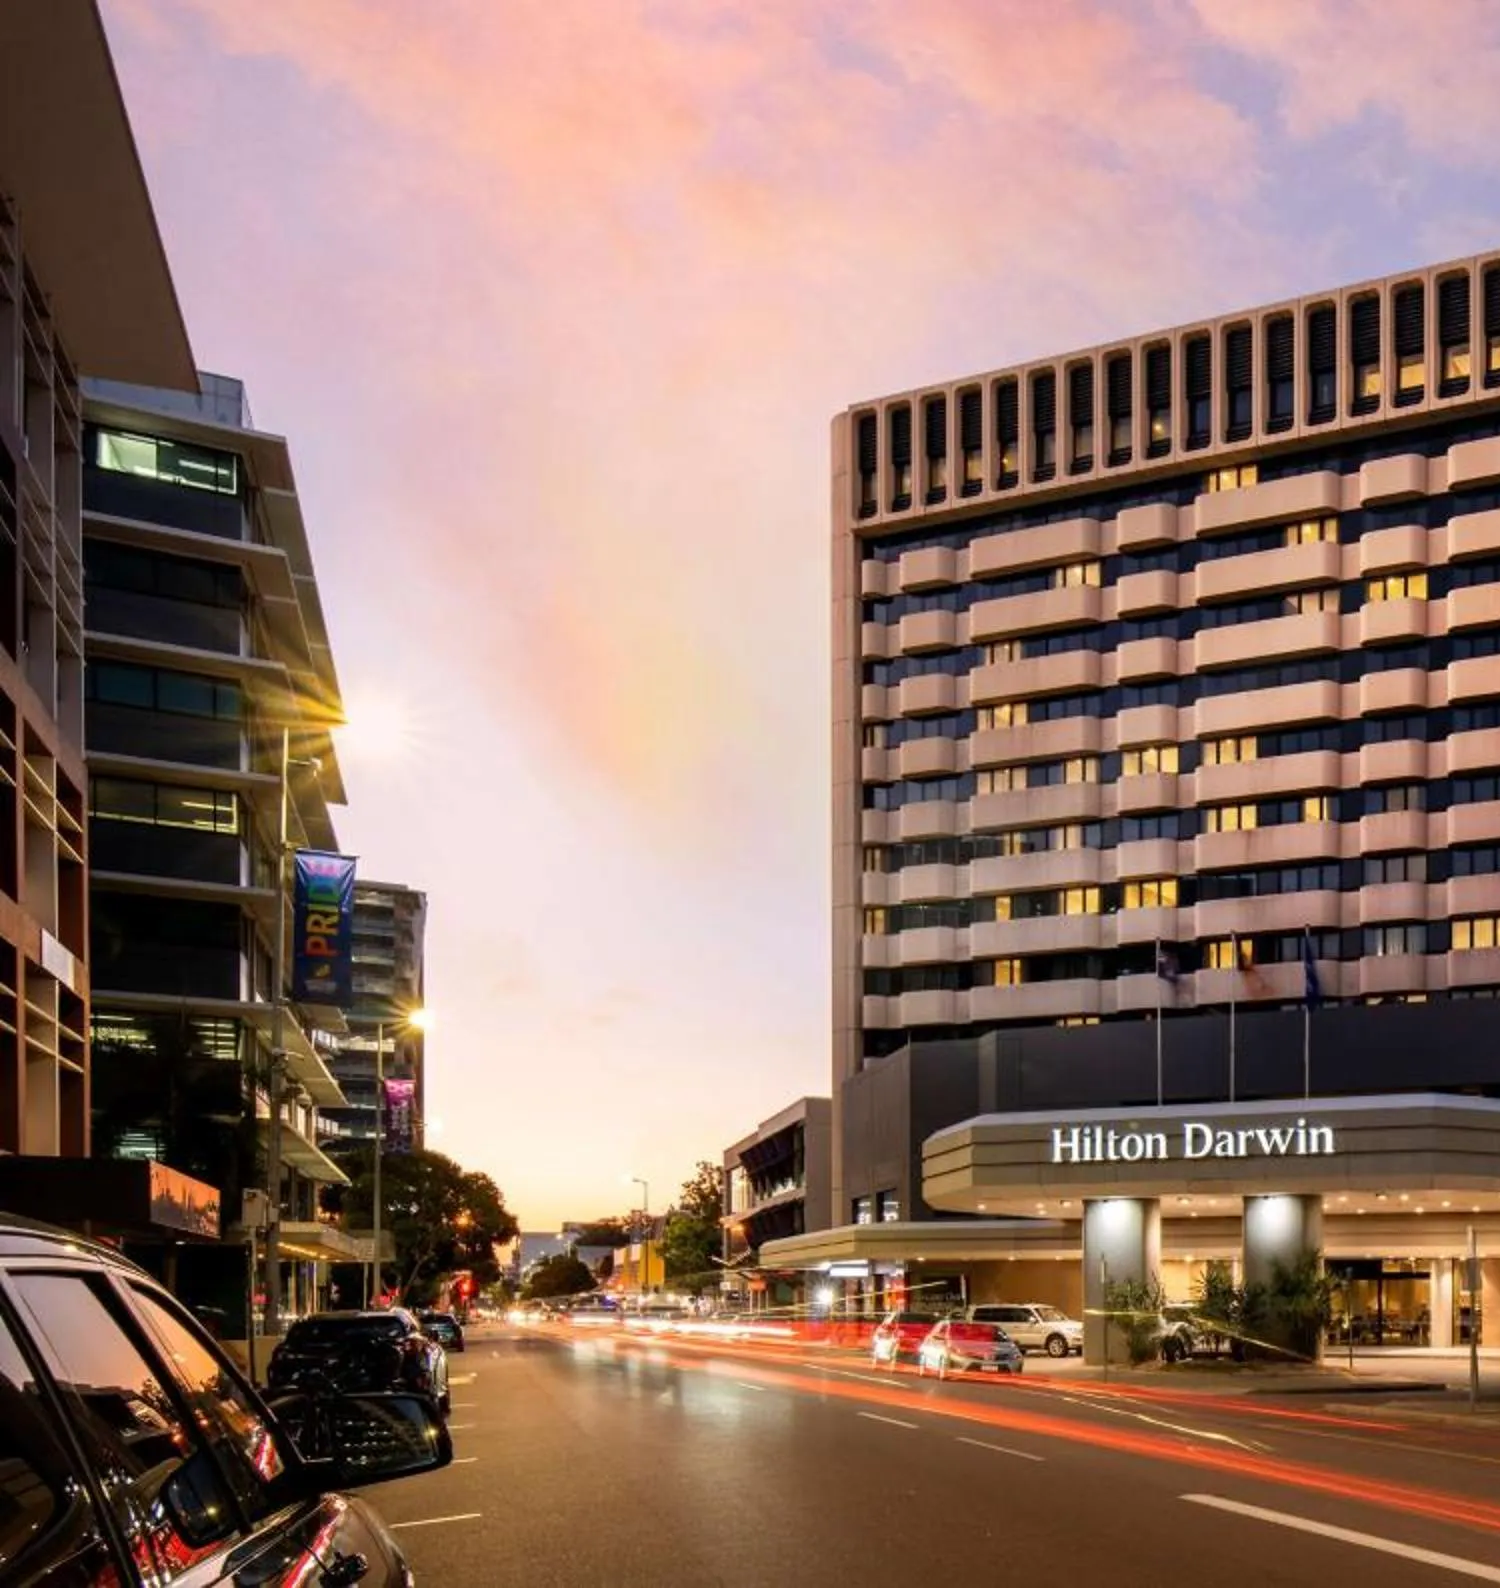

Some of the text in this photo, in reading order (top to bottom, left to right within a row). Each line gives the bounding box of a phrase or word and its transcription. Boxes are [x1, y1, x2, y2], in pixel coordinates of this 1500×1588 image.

[305, 859, 339, 957] PRIDE
[1052, 1117, 1335, 1163] Hilton Darwin
